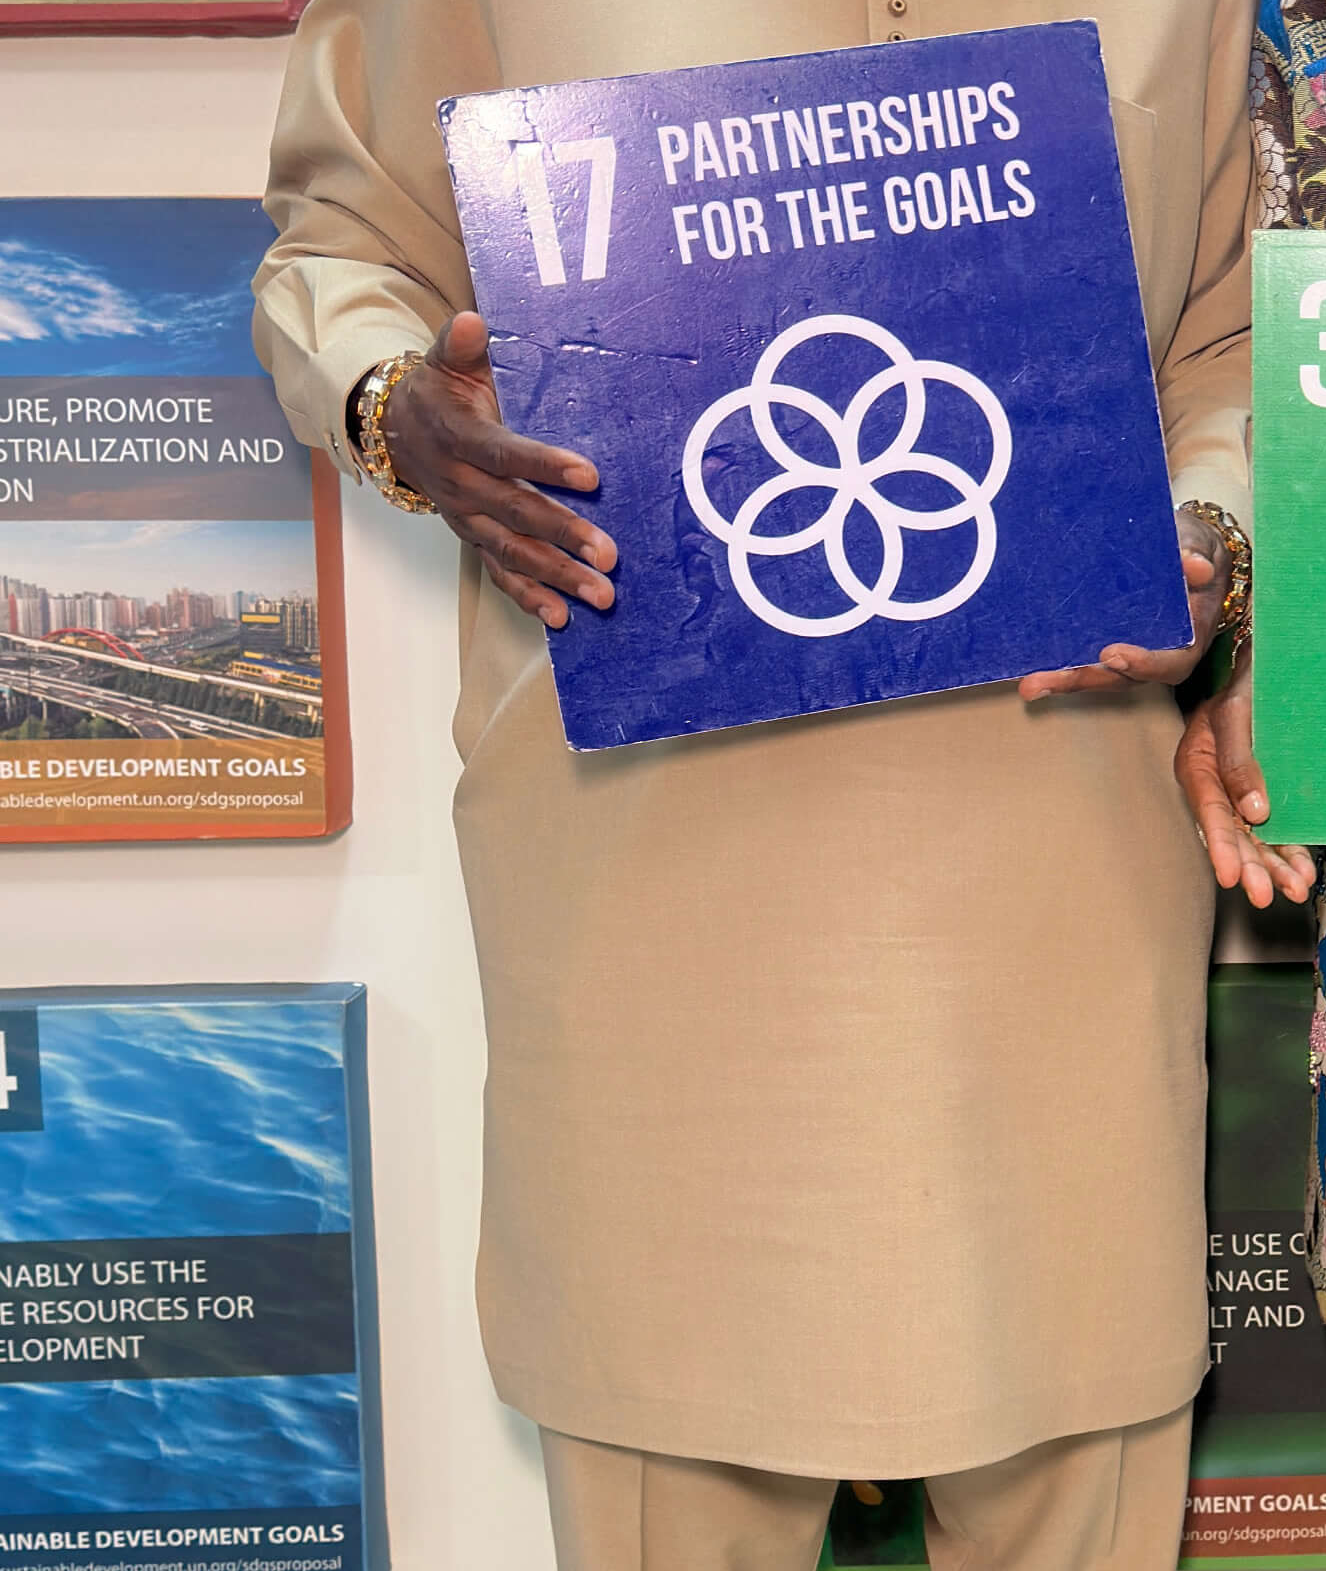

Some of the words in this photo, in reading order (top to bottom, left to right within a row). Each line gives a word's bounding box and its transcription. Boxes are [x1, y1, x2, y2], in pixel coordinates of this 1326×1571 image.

[657, 81, 1020, 185] PARTNERSHIPS
[672, 202, 770, 265] FOR
[775, 181, 876, 249] THE
[885, 160, 1036, 235] GOALS
[66, 398, 213, 424] PROMOTE
[218, 438, 284, 464] AND
[47, 758, 222, 778] DEVELOPMENT
[227, 757, 306, 777] GOALS
[1231, 1233, 1283, 1256] USE
[92, 1261, 147, 1285] USE
[151, 1259, 208, 1284] THE
[23, 1296, 189, 1326] RESOURCES
[198, 1295, 254, 1321] FOR
[1244, 1304, 1305, 1328] AND
[95, 1527, 263, 1549] DEVELOPMENT
[267, 1524, 345, 1544] GOALS
